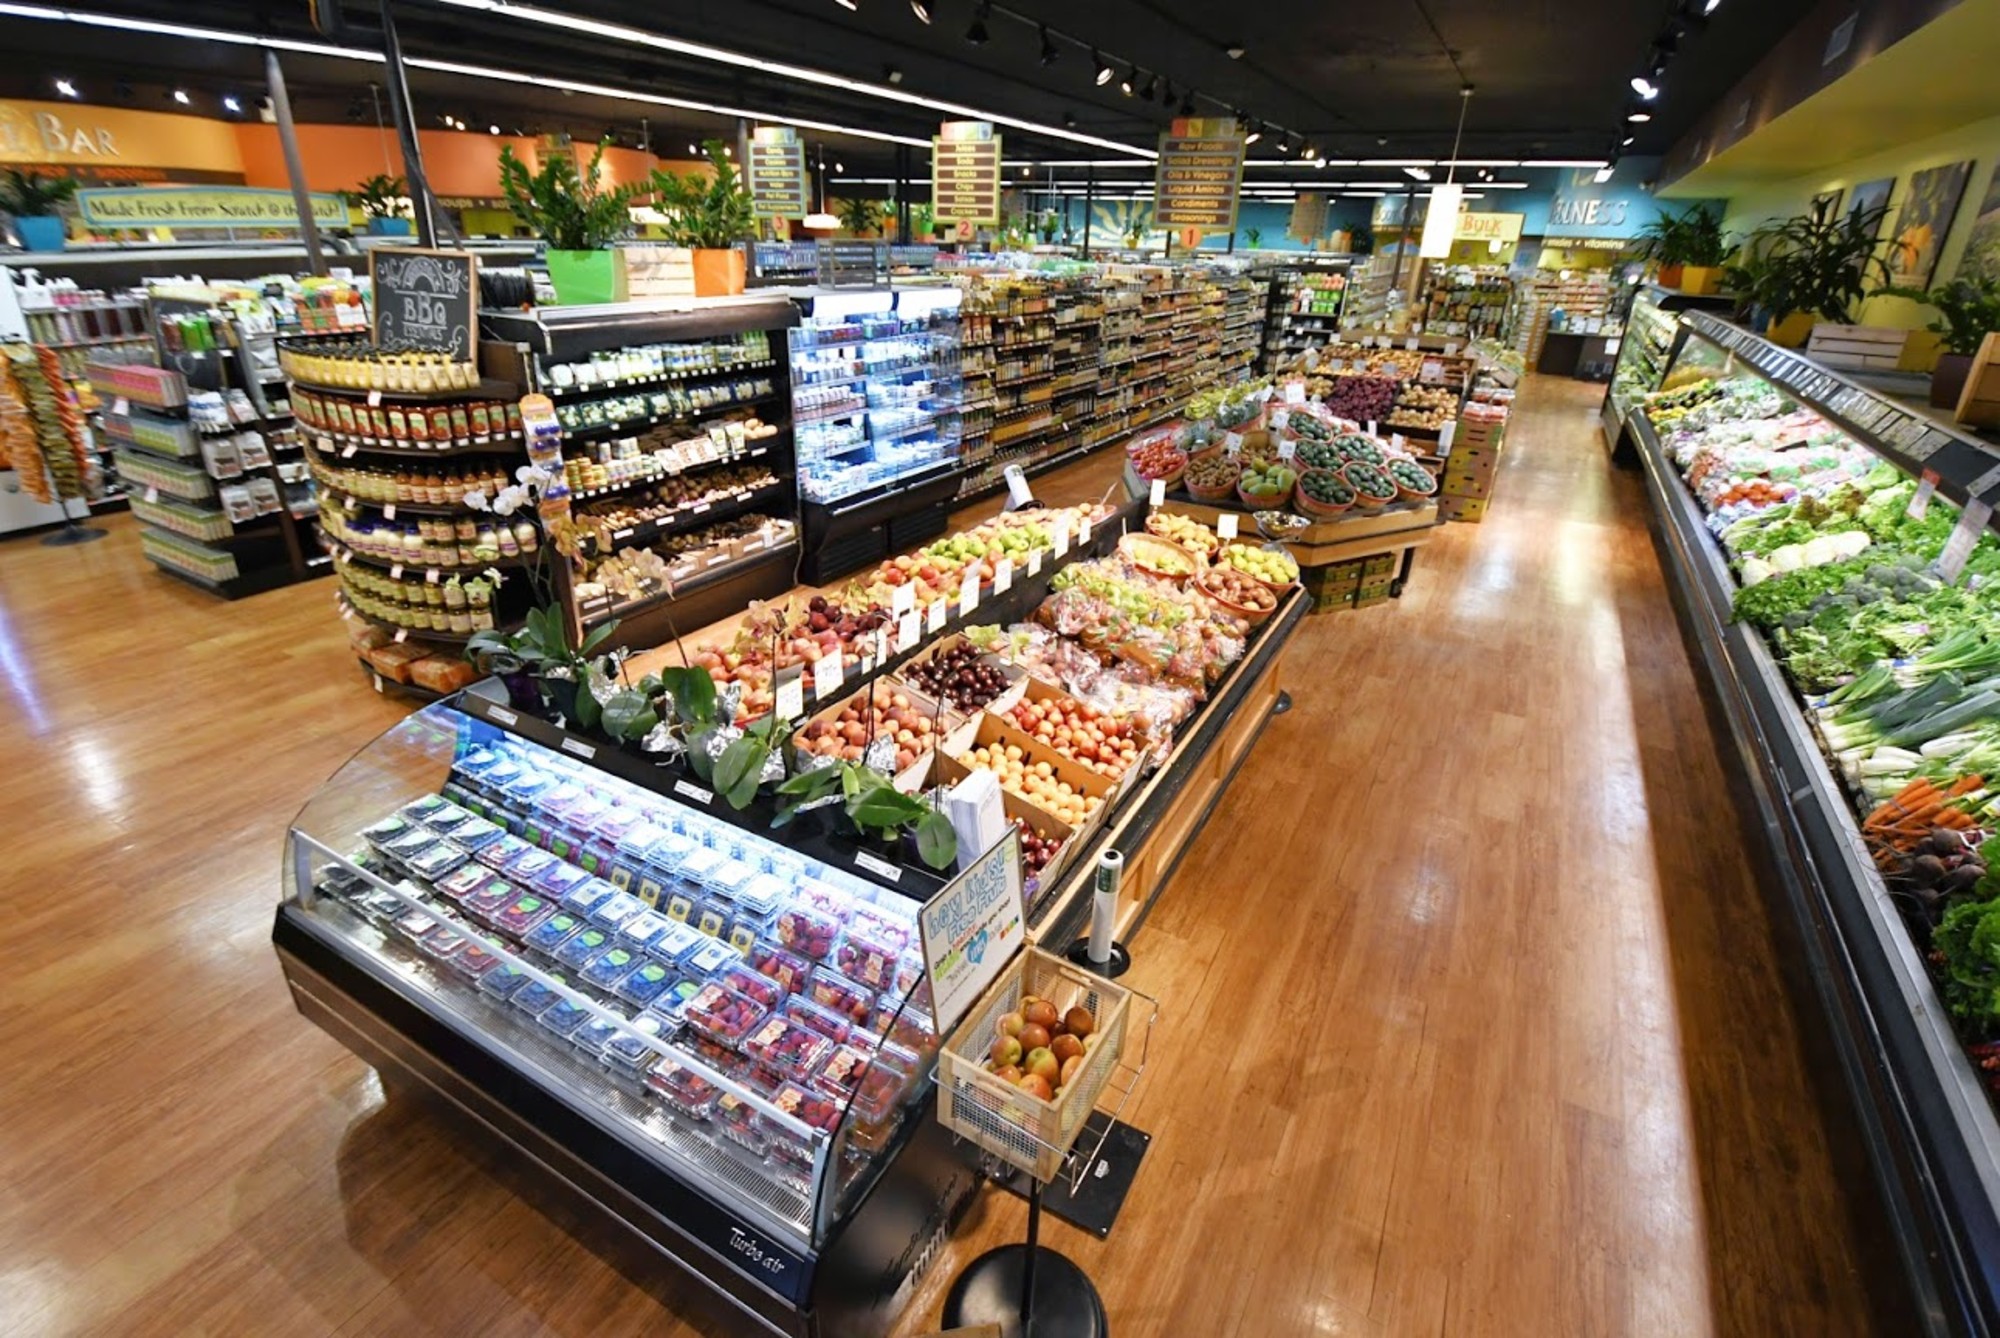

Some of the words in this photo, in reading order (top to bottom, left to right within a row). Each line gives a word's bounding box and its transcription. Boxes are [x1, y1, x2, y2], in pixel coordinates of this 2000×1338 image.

[1193, 171, 1229, 181] Vinegars
[1171, 199, 1218, 209] Condiments
[1170, 213, 1217, 225] Seasonings
[959, 220, 969, 237] 2
[1186, 229, 1195, 246] 1
[403, 291, 447, 326] BBQ
[947, 905, 977, 945] Free
[730, 1226, 763, 1262] Turbo
[762, 1257, 785, 1274] air
